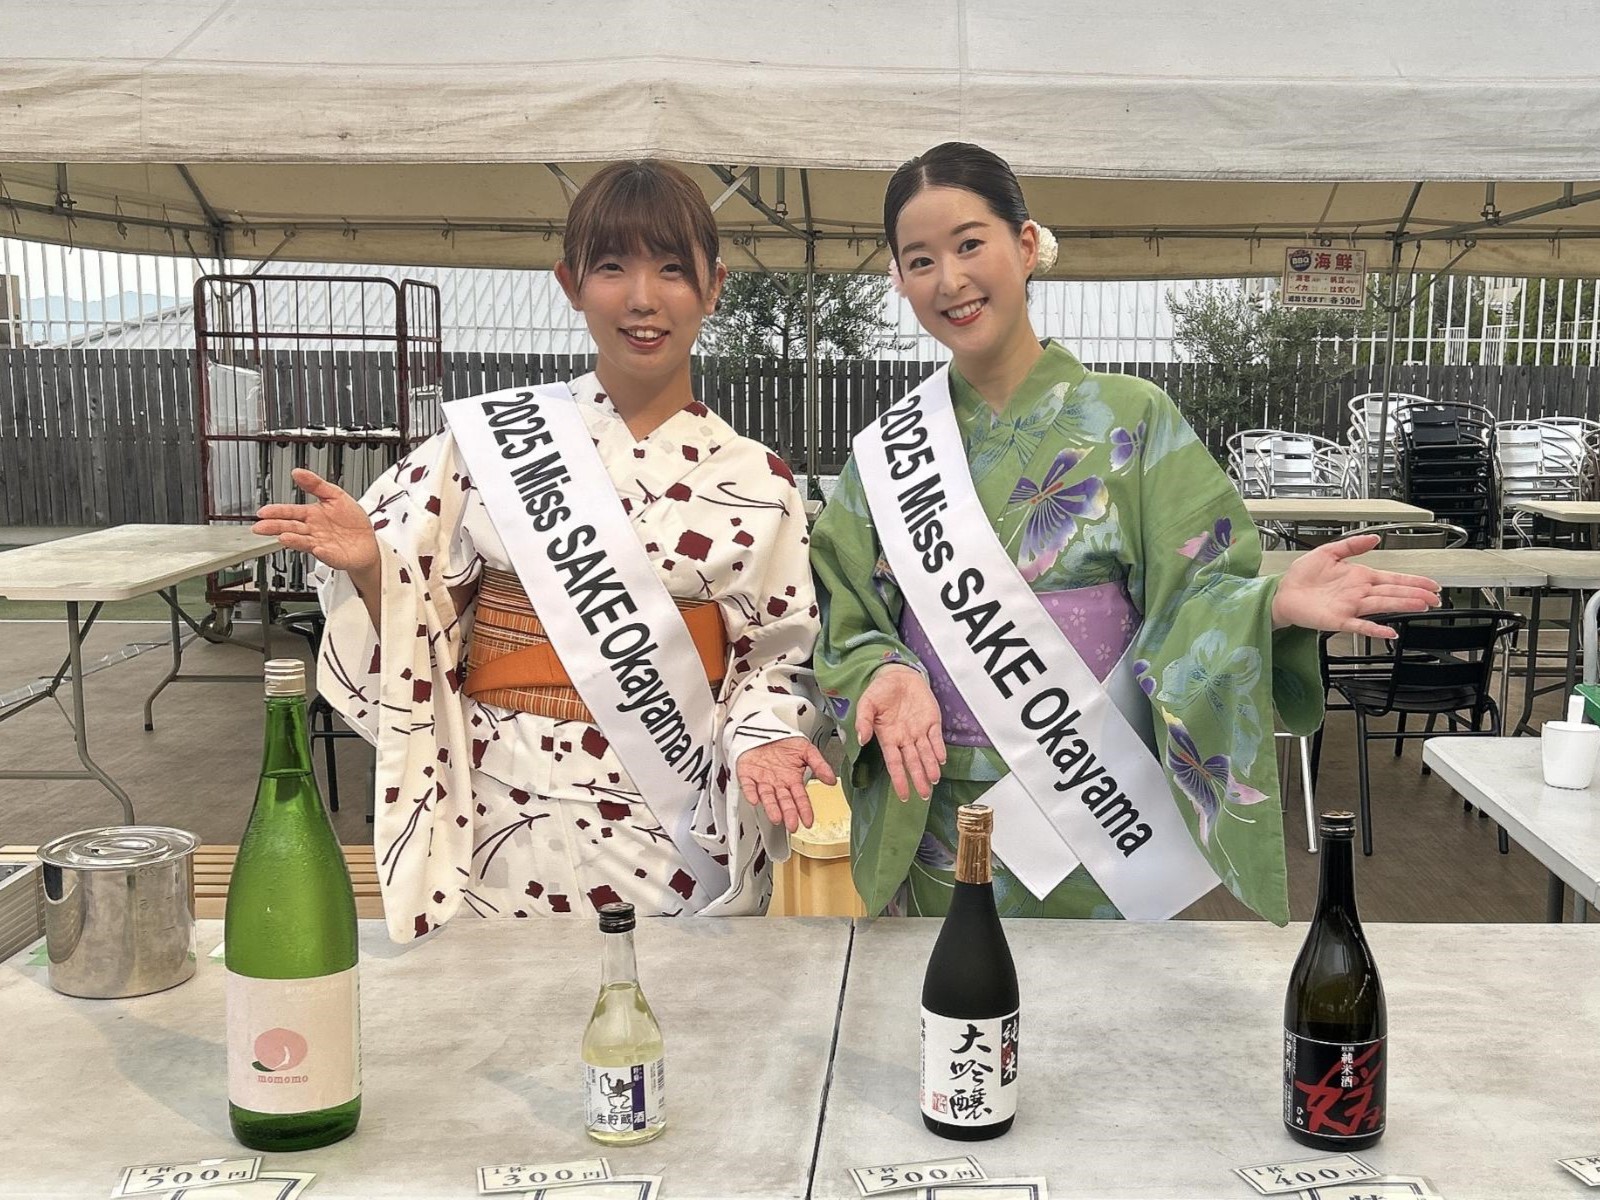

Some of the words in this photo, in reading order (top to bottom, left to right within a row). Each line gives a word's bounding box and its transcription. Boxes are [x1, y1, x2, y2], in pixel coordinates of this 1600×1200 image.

[1314, 252, 1353, 271] 海鮮
[480, 391, 554, 460] 2025
[879, 394, 935, 480] 2025
[510, 450, 572, 532] Miss
[897, 472, 954, 574] Miss
[546, 524, 638, 636] SAKE
[940, 567, 1048, 700] SAKE
[600, 622, 692, 768] Okayama
[1020, 687, 1153, 858] Okayama
[257, 1074, 309, 1084] momomo
[1340, 1052, 1354, 1088] 純米酒
[1274, 1167, 1368, 1186] 400円
